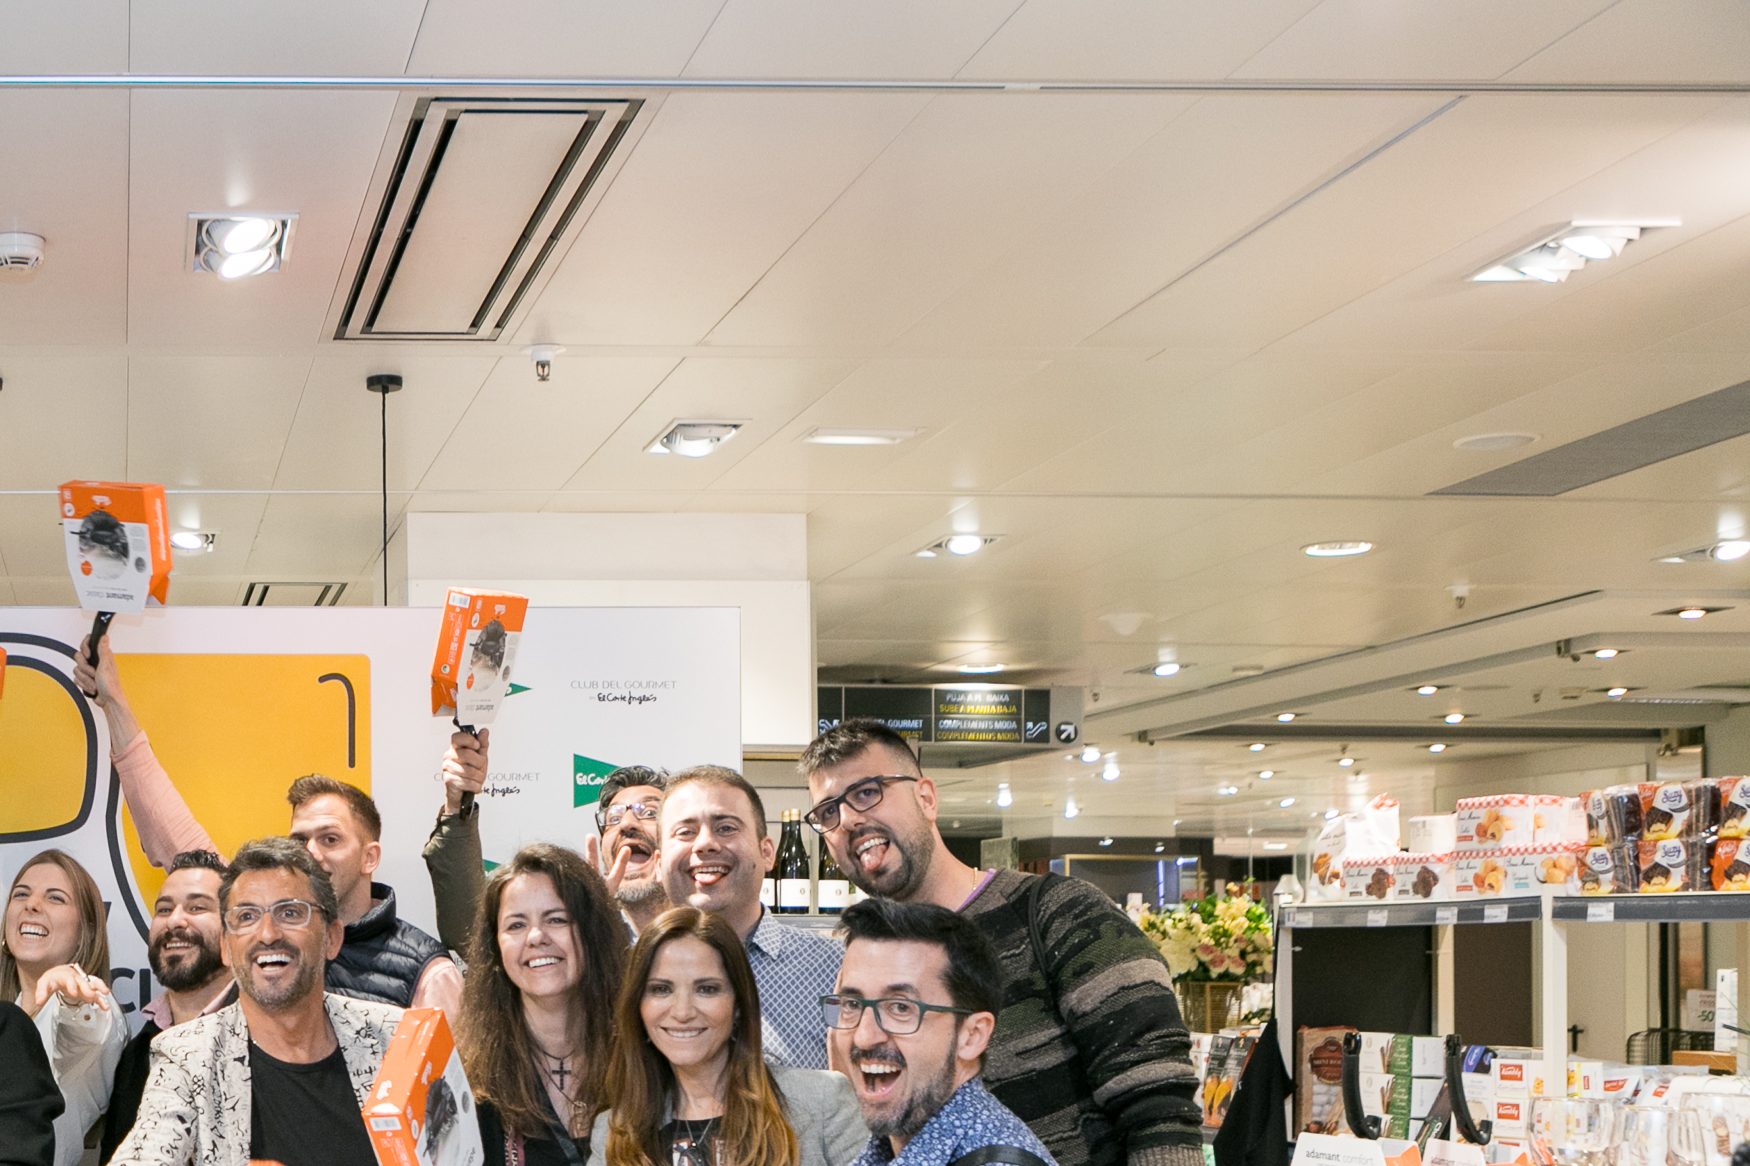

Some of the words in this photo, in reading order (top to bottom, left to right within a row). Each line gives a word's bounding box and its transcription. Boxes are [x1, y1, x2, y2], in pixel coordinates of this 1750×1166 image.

[570, 680, 598, 689] CLUB
[602, 680, 622, 689] DEL
[624, 680, 678, 689] GOURMET
[606, 692, 627, 702] Corte
[628, 690, 657, 705] Inglés
[887, 720, 924, 729] GOURMET
[939, 719, 994, 730] COMPLEMENTS
[994, 720, 1017, 729] MODA
[995, 731, 1020, 740] MODA
[487, 772, 541, 781] GOURMET
[491, 783, 521, 797] Inglés
[1305, 1150, 1341, 1162] adamant
[1342, 1154, 1374, 1166] comfort
